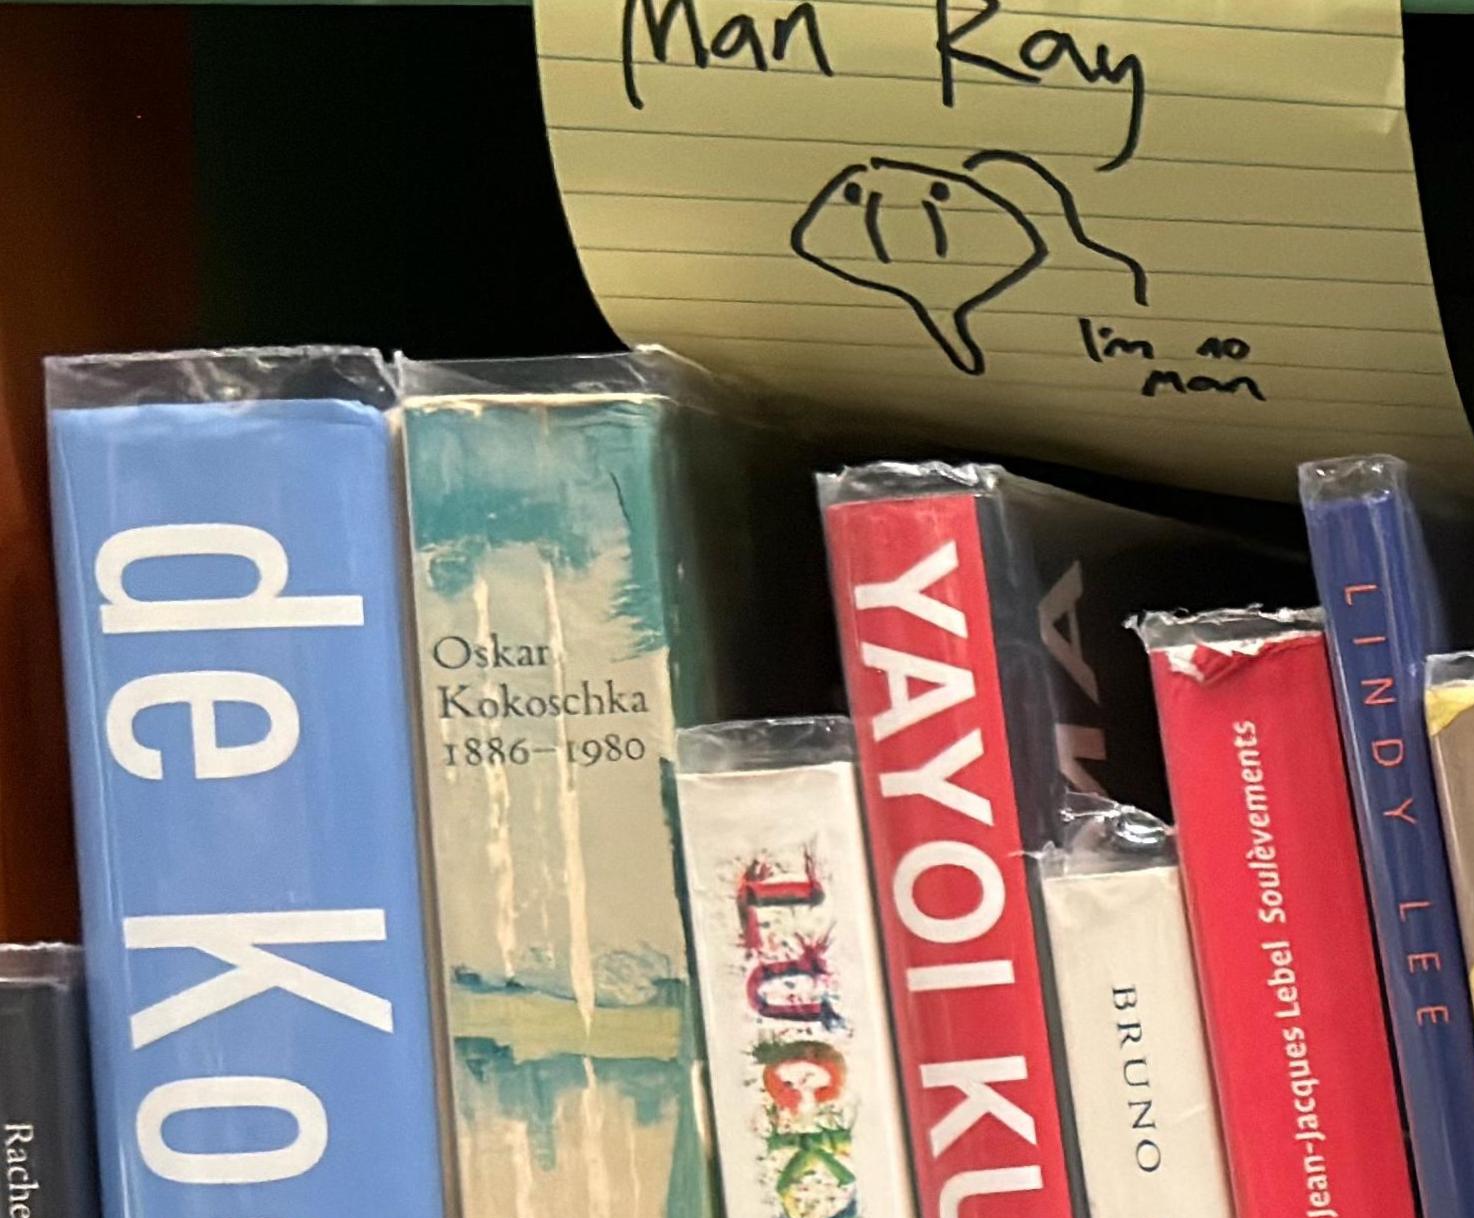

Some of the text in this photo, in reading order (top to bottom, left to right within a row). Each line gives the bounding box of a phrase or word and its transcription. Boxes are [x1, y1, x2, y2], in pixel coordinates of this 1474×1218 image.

[622, 0, 1145, 172] Man Ray
[93, 522, 365, 782] de
[432, 633, 550, 673] Oskar
[438, 680, 650, 722] Kokoschka
[851, 537, 1016, 994] YAYOI
[1345, 582, 1451, 1029] LINDY LEE
[1112, 984, 1162, 1176] BRUNO
[1233, 719, 1338, 1218] Jean-Jacques Lebel Soulèvements
